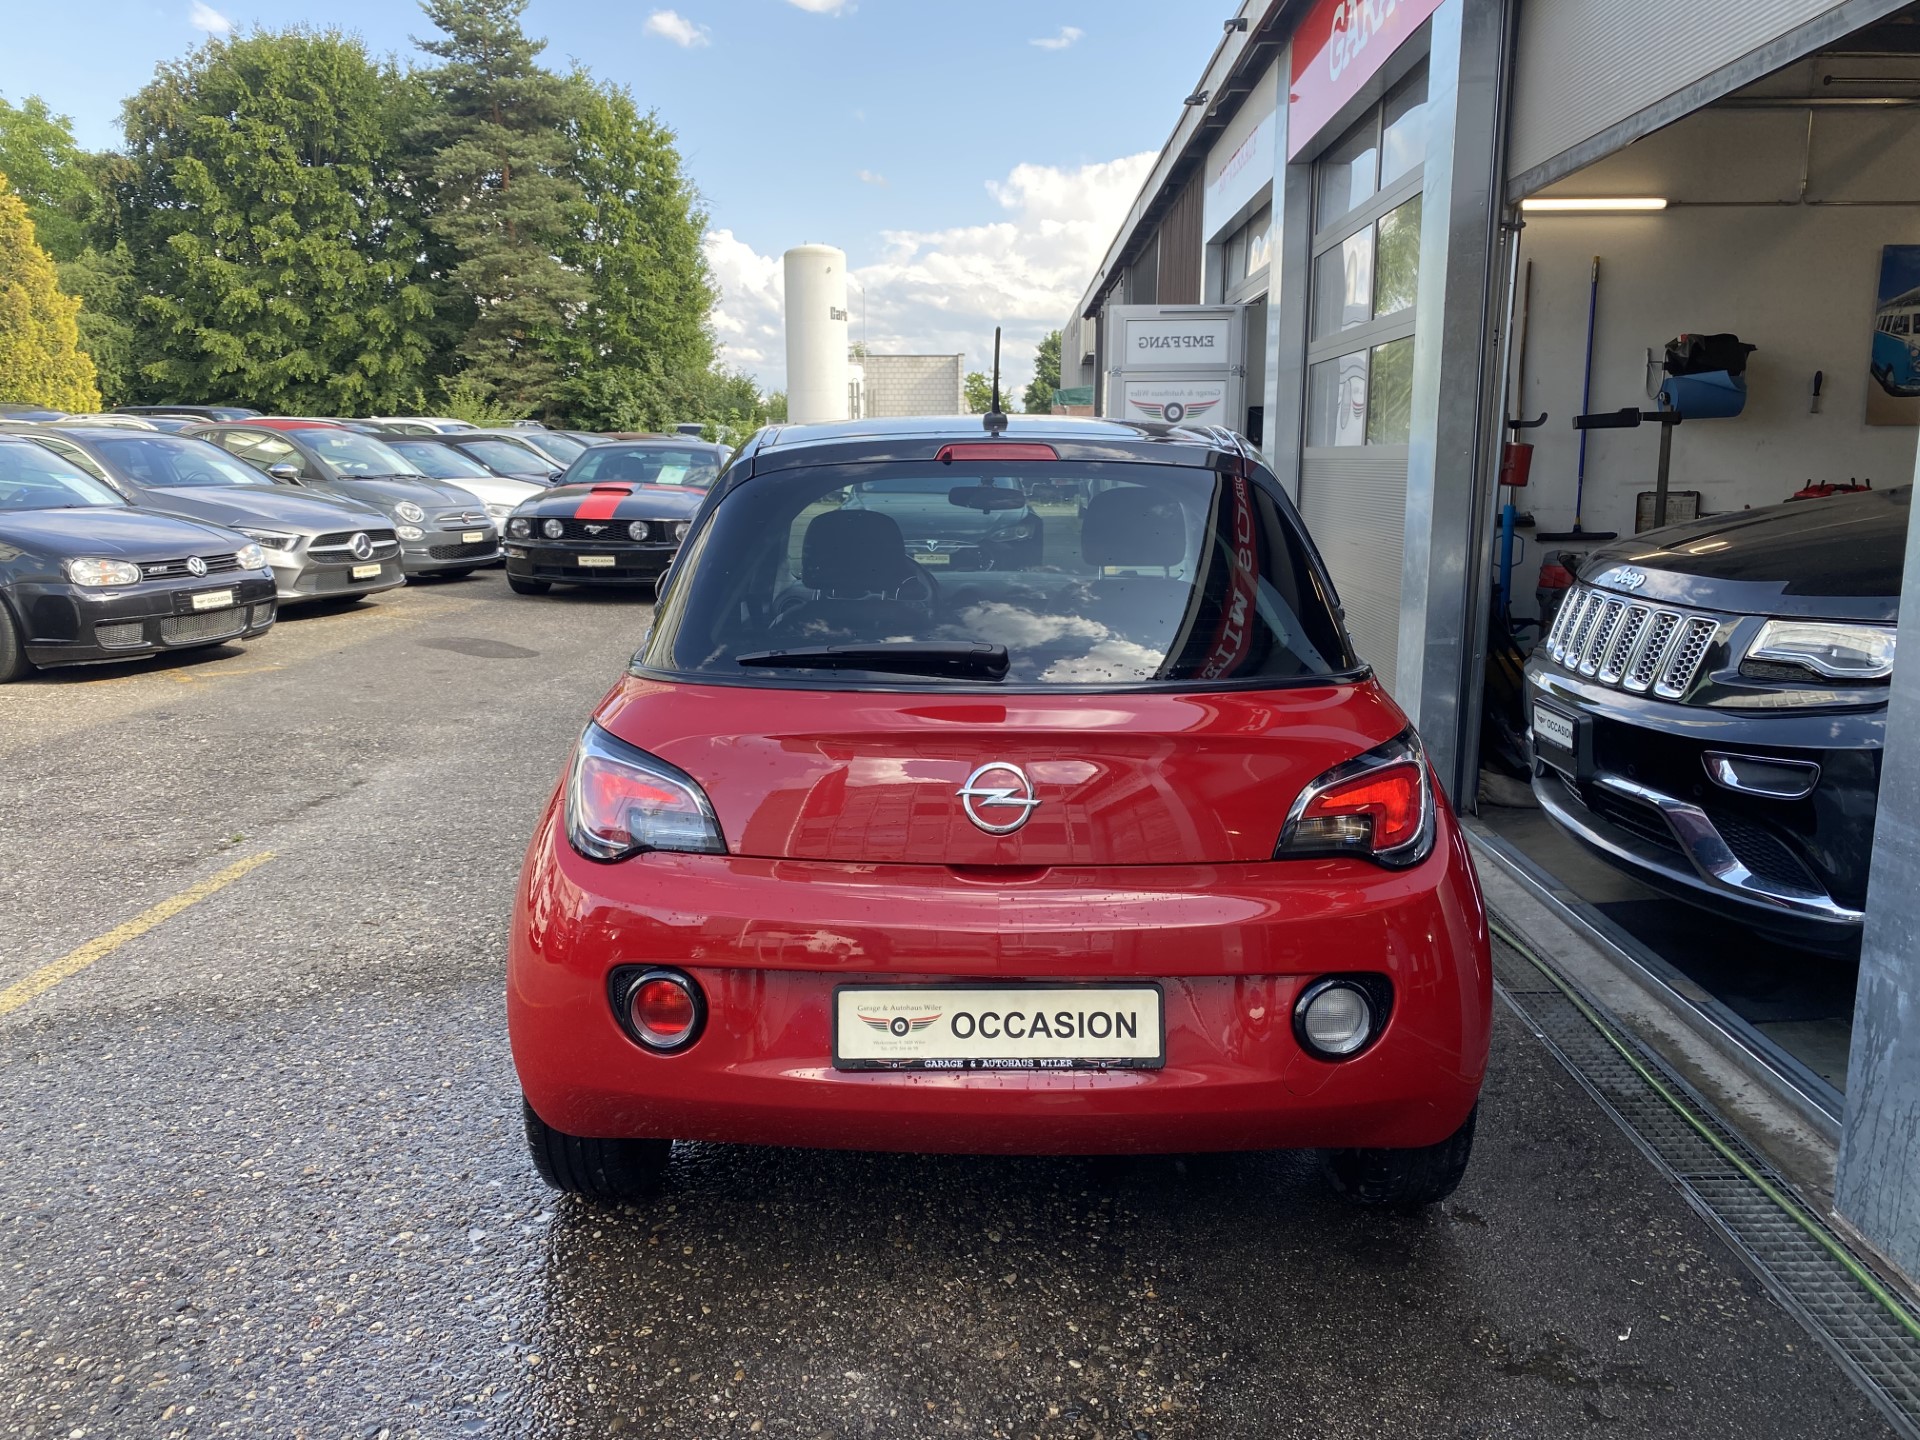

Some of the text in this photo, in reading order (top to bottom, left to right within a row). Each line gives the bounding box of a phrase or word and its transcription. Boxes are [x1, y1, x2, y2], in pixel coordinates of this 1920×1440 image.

[1613, 567, 1647, 591] Jeep
[857, 1005, 881, 1013] Garage
[950, 1011, 1137, 1039] OCCASION
[924, 1060, 964, 1069] GARAGE
[982, 1059, 1034, 1068] AUTOHAUS
[1040, 1059, 1073, 1068] WILER
